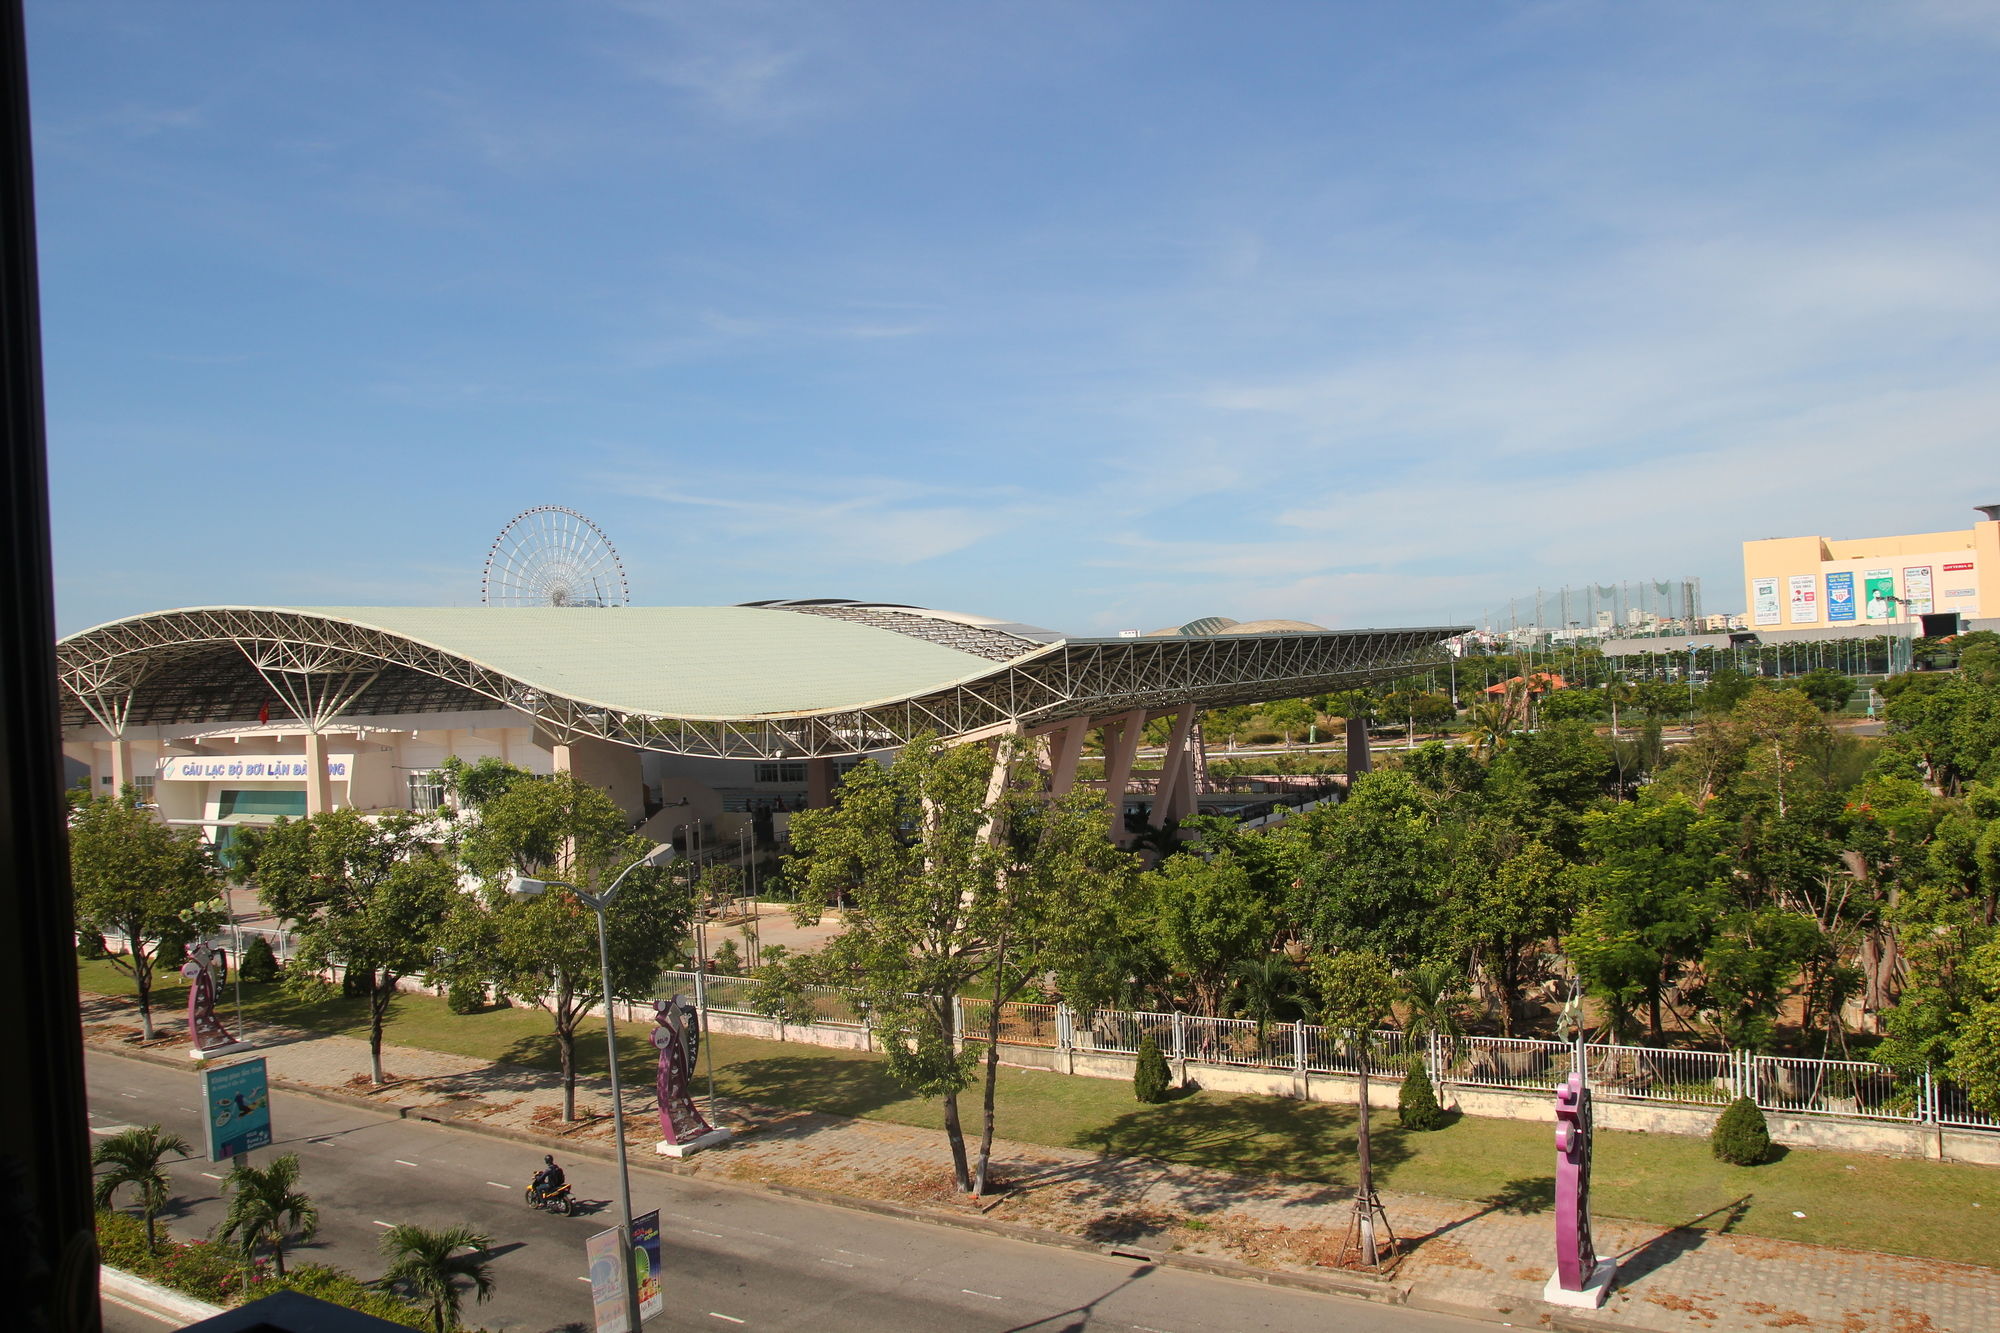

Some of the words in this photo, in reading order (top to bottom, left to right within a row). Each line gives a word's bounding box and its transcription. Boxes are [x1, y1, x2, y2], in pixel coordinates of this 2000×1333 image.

[205, 764, 225, 779] LẠC
[228, 761, 243, 779] BỘ
[246, 763, 264, 776] BƠI
[267, 761, 290, 779] LẶN
